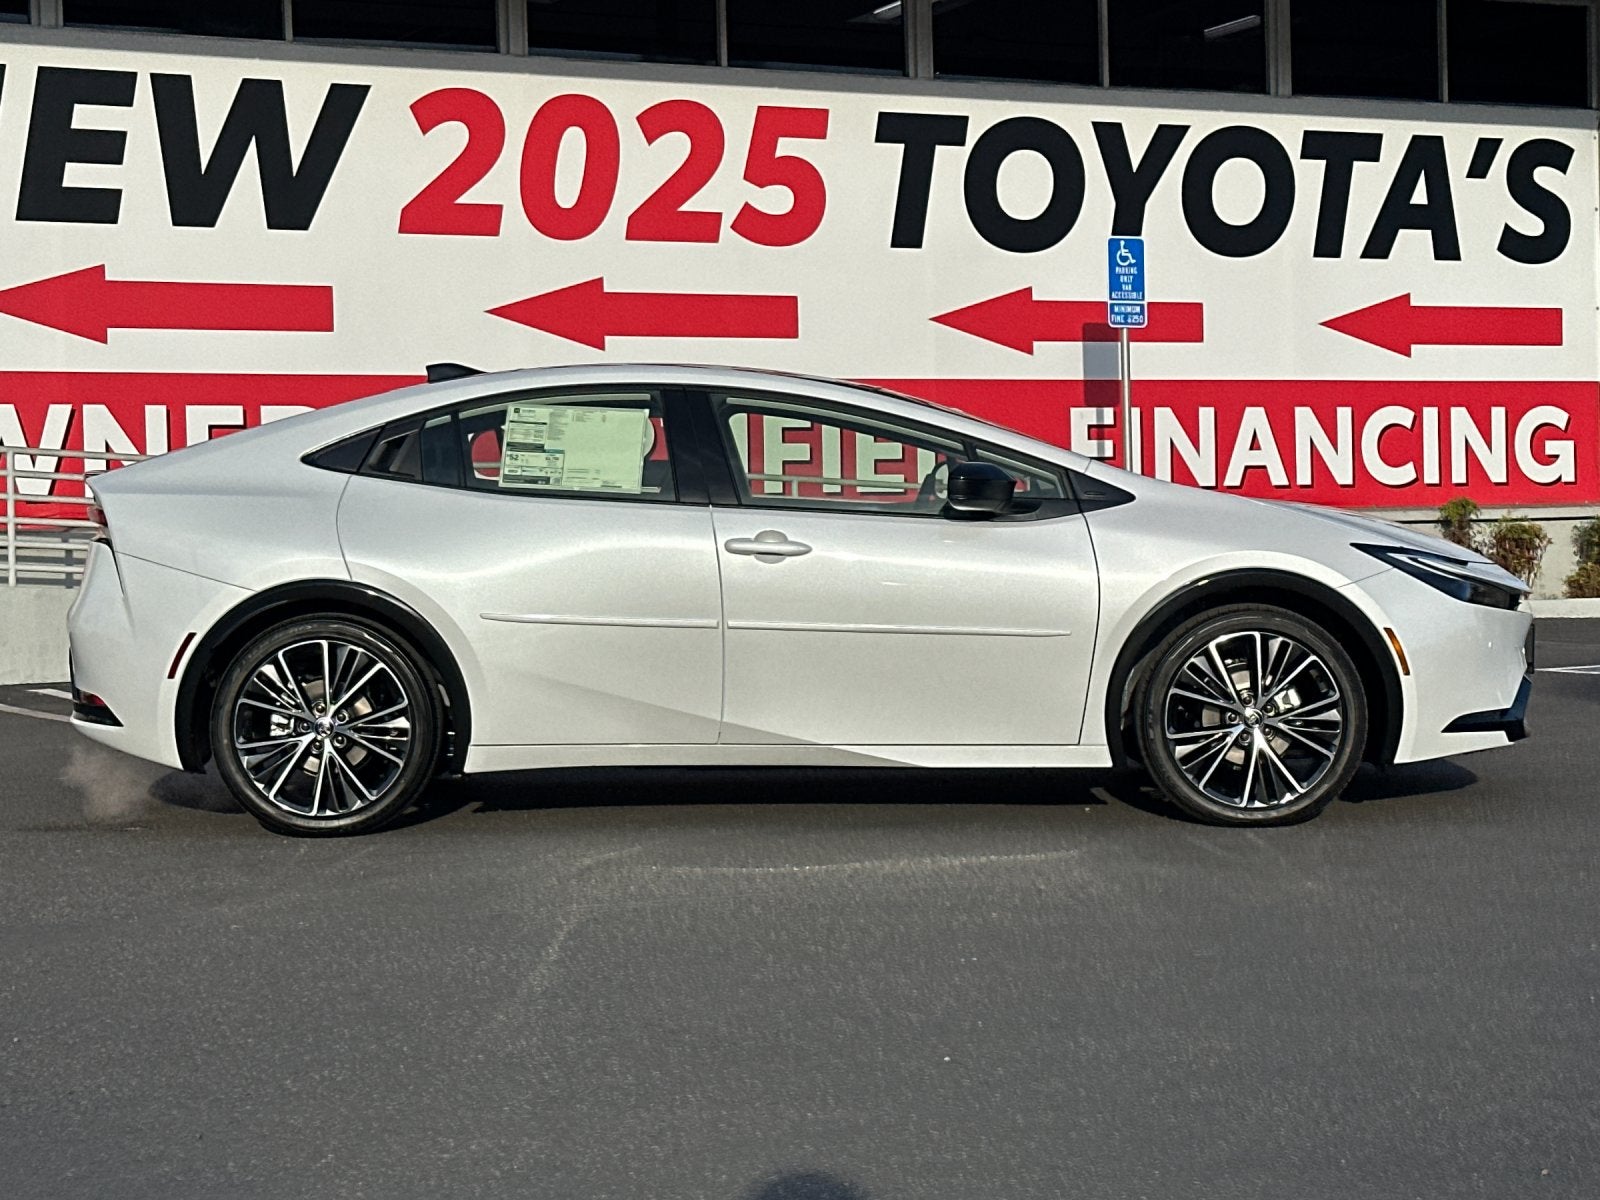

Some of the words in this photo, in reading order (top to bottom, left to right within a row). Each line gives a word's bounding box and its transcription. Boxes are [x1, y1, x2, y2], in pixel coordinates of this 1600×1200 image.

[0, 65, 372, 231] EW
[399, 87, 829, 247] 2025
[874, 111, 1576, 265] TOYOTA'S
